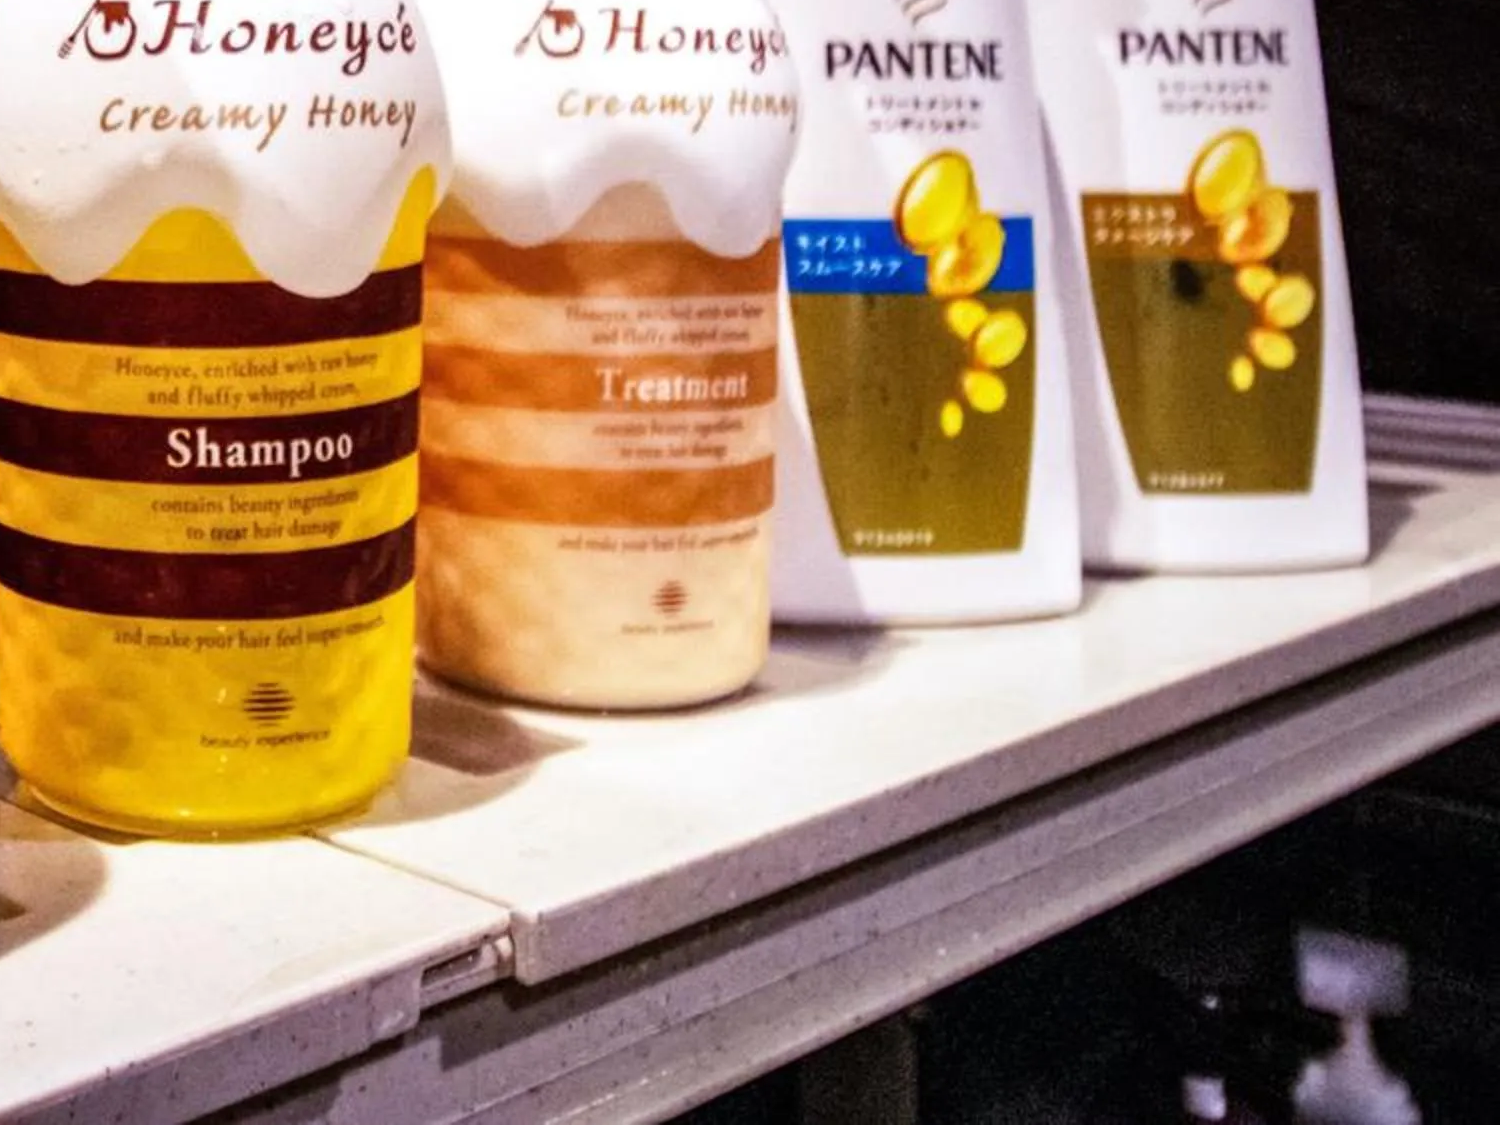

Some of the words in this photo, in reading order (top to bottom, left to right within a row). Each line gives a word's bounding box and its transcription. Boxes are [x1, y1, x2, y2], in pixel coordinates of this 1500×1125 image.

[825, 41, 1004, 80] PANTENE
[1118, 29, 1289, 66] PANTENE
[100, 98, 287, 152] Creamy
[307, 94, 416, 148] Honey
[557, 87, 714, 135] Creamy
[204, 358, 277, 378] enriched
[596, 368, 749, 401] Treatment
[148, 388, 178, 406] and
[188, 385, 243, 407] fluffy
[250, 382, 315, 407] whipped
[167, 427, 353, 478] Shampoo
[151, 497, 224, 514] contains
[253, 521, 282, 540] hair
[114, 628, 143, 645] and
[147, 630, 189, 650] make
[195, 635, 232, 653] your
[238, 629, 271, 649] hair
